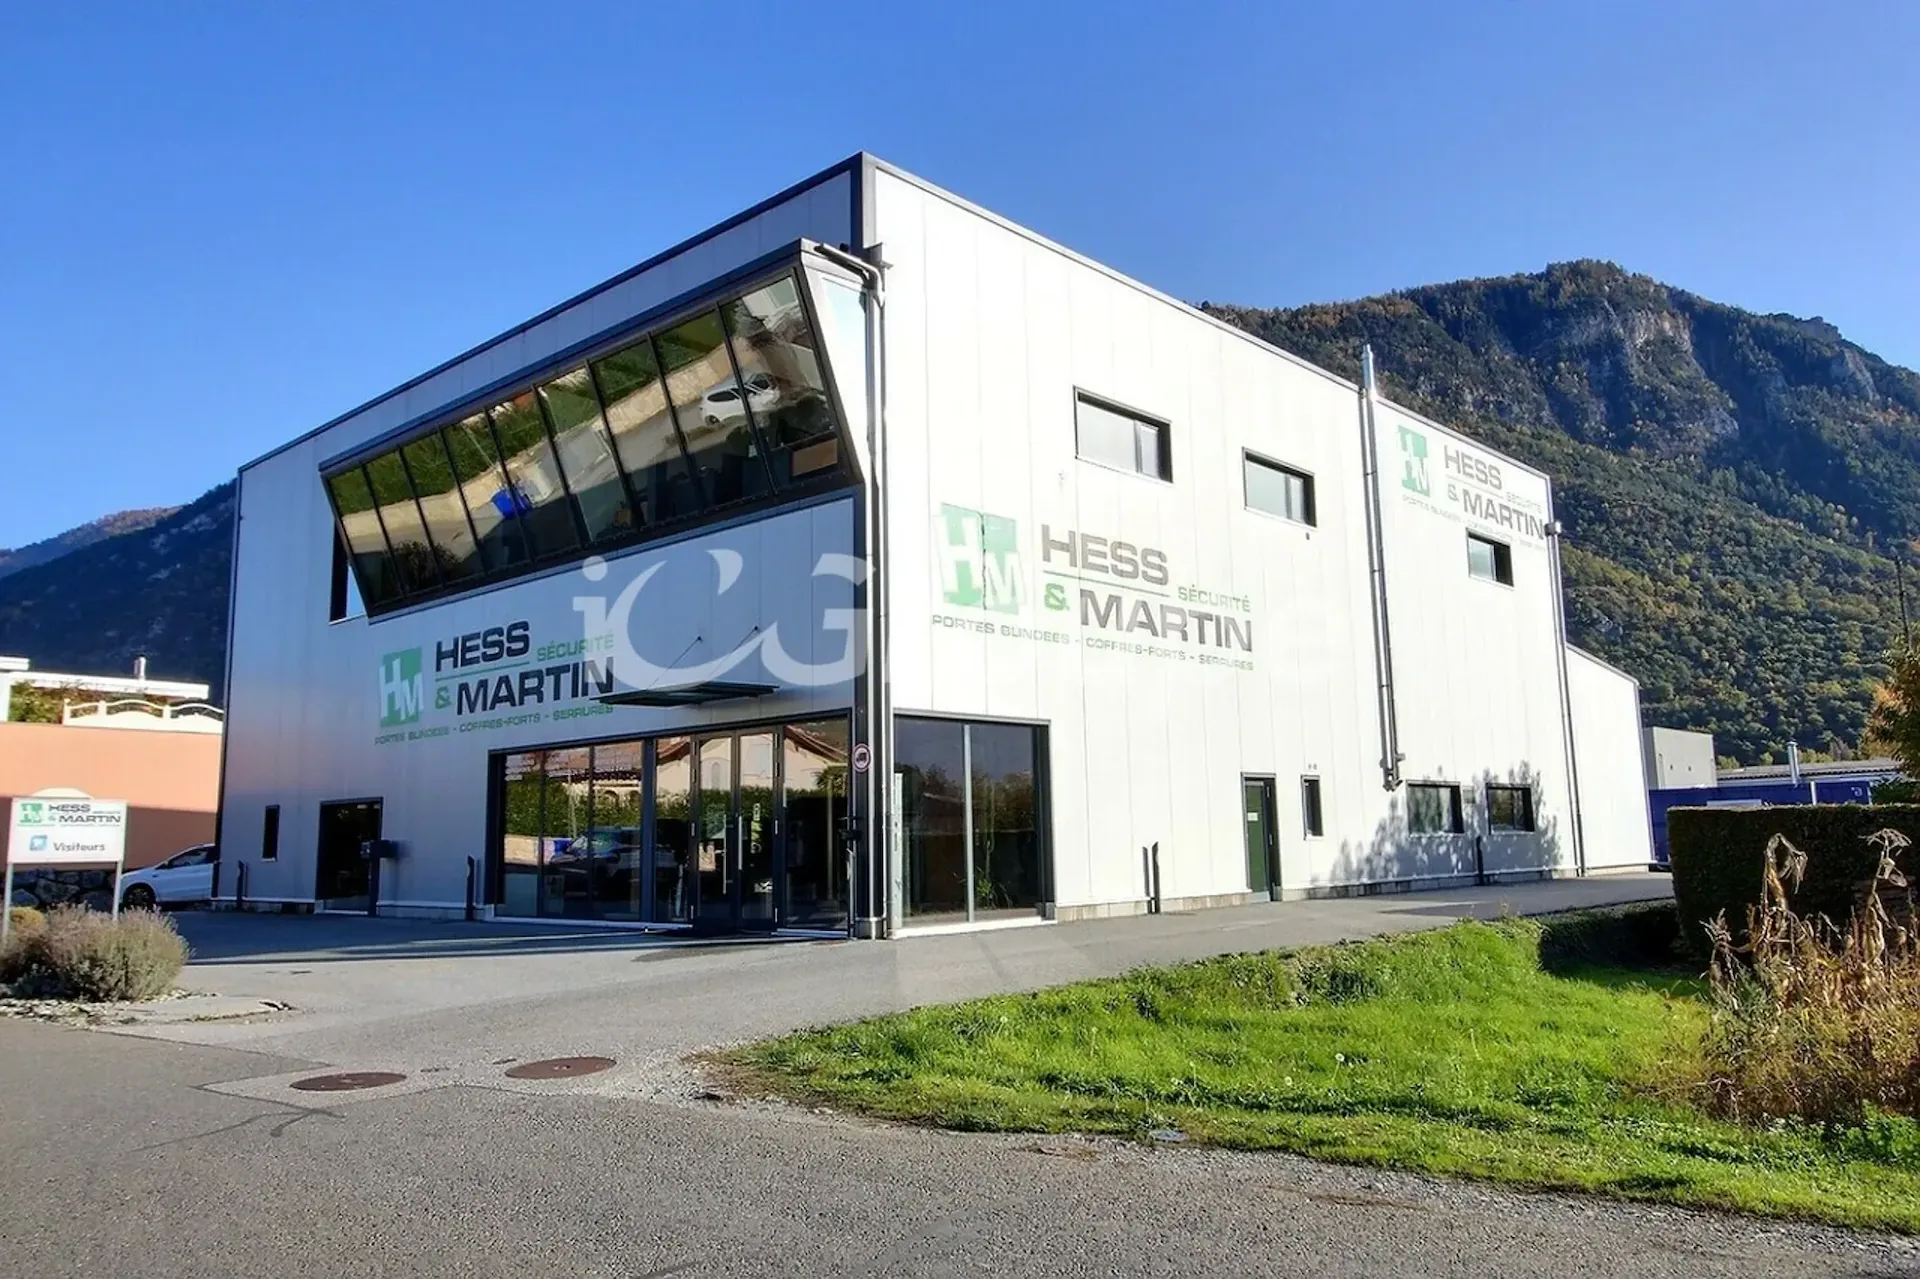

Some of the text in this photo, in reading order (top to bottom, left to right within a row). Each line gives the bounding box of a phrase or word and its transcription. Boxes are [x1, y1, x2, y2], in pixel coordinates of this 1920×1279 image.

[1444, 444, 1503, 490] HESS
[1447, 483, 1459, 502] &
[1462, 489, 1544, 540] MARTIN
[932, 514, 1027, 608] HM
[1041, 524, 1169, 586] HESS
[1044, 582, 1253, 653] & MARTIN
[1178, 584, 1253, 613] SÉCURITÉ
[436, 621, 530, 672] HESS
[932, 614, 995, 634] PORTES
[1085, 637, 1186, 661] COFFRES-FORTS
[435, 656, 614, 715] & MARTIN
[374, 731, 406, 745] PORTES
[48, 803, 91, 813] HESS
[58, 815, 121, 823] MARTIN
[53, 842, 105, 852] Visiteurs
